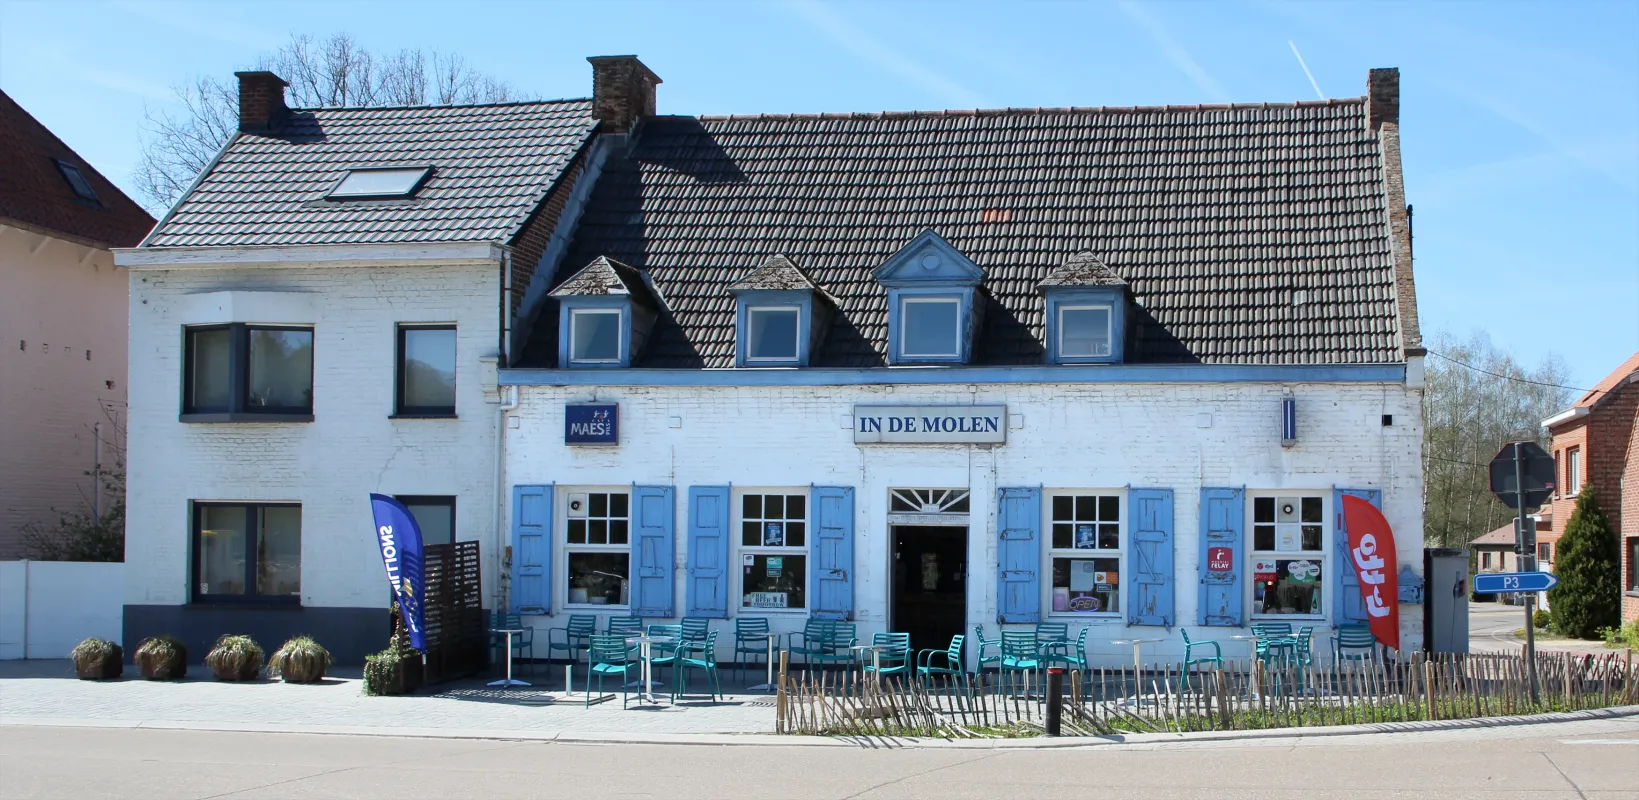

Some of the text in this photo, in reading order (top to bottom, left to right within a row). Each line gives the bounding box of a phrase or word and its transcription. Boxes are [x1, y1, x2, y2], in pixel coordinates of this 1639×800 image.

[570, 422, 605, 436] MAES
[859, 417, 999, 433] IN DE MOLEN
[1503, 576, 1520, 589] P3
[1069, 599, 1099, 609] OPEN
